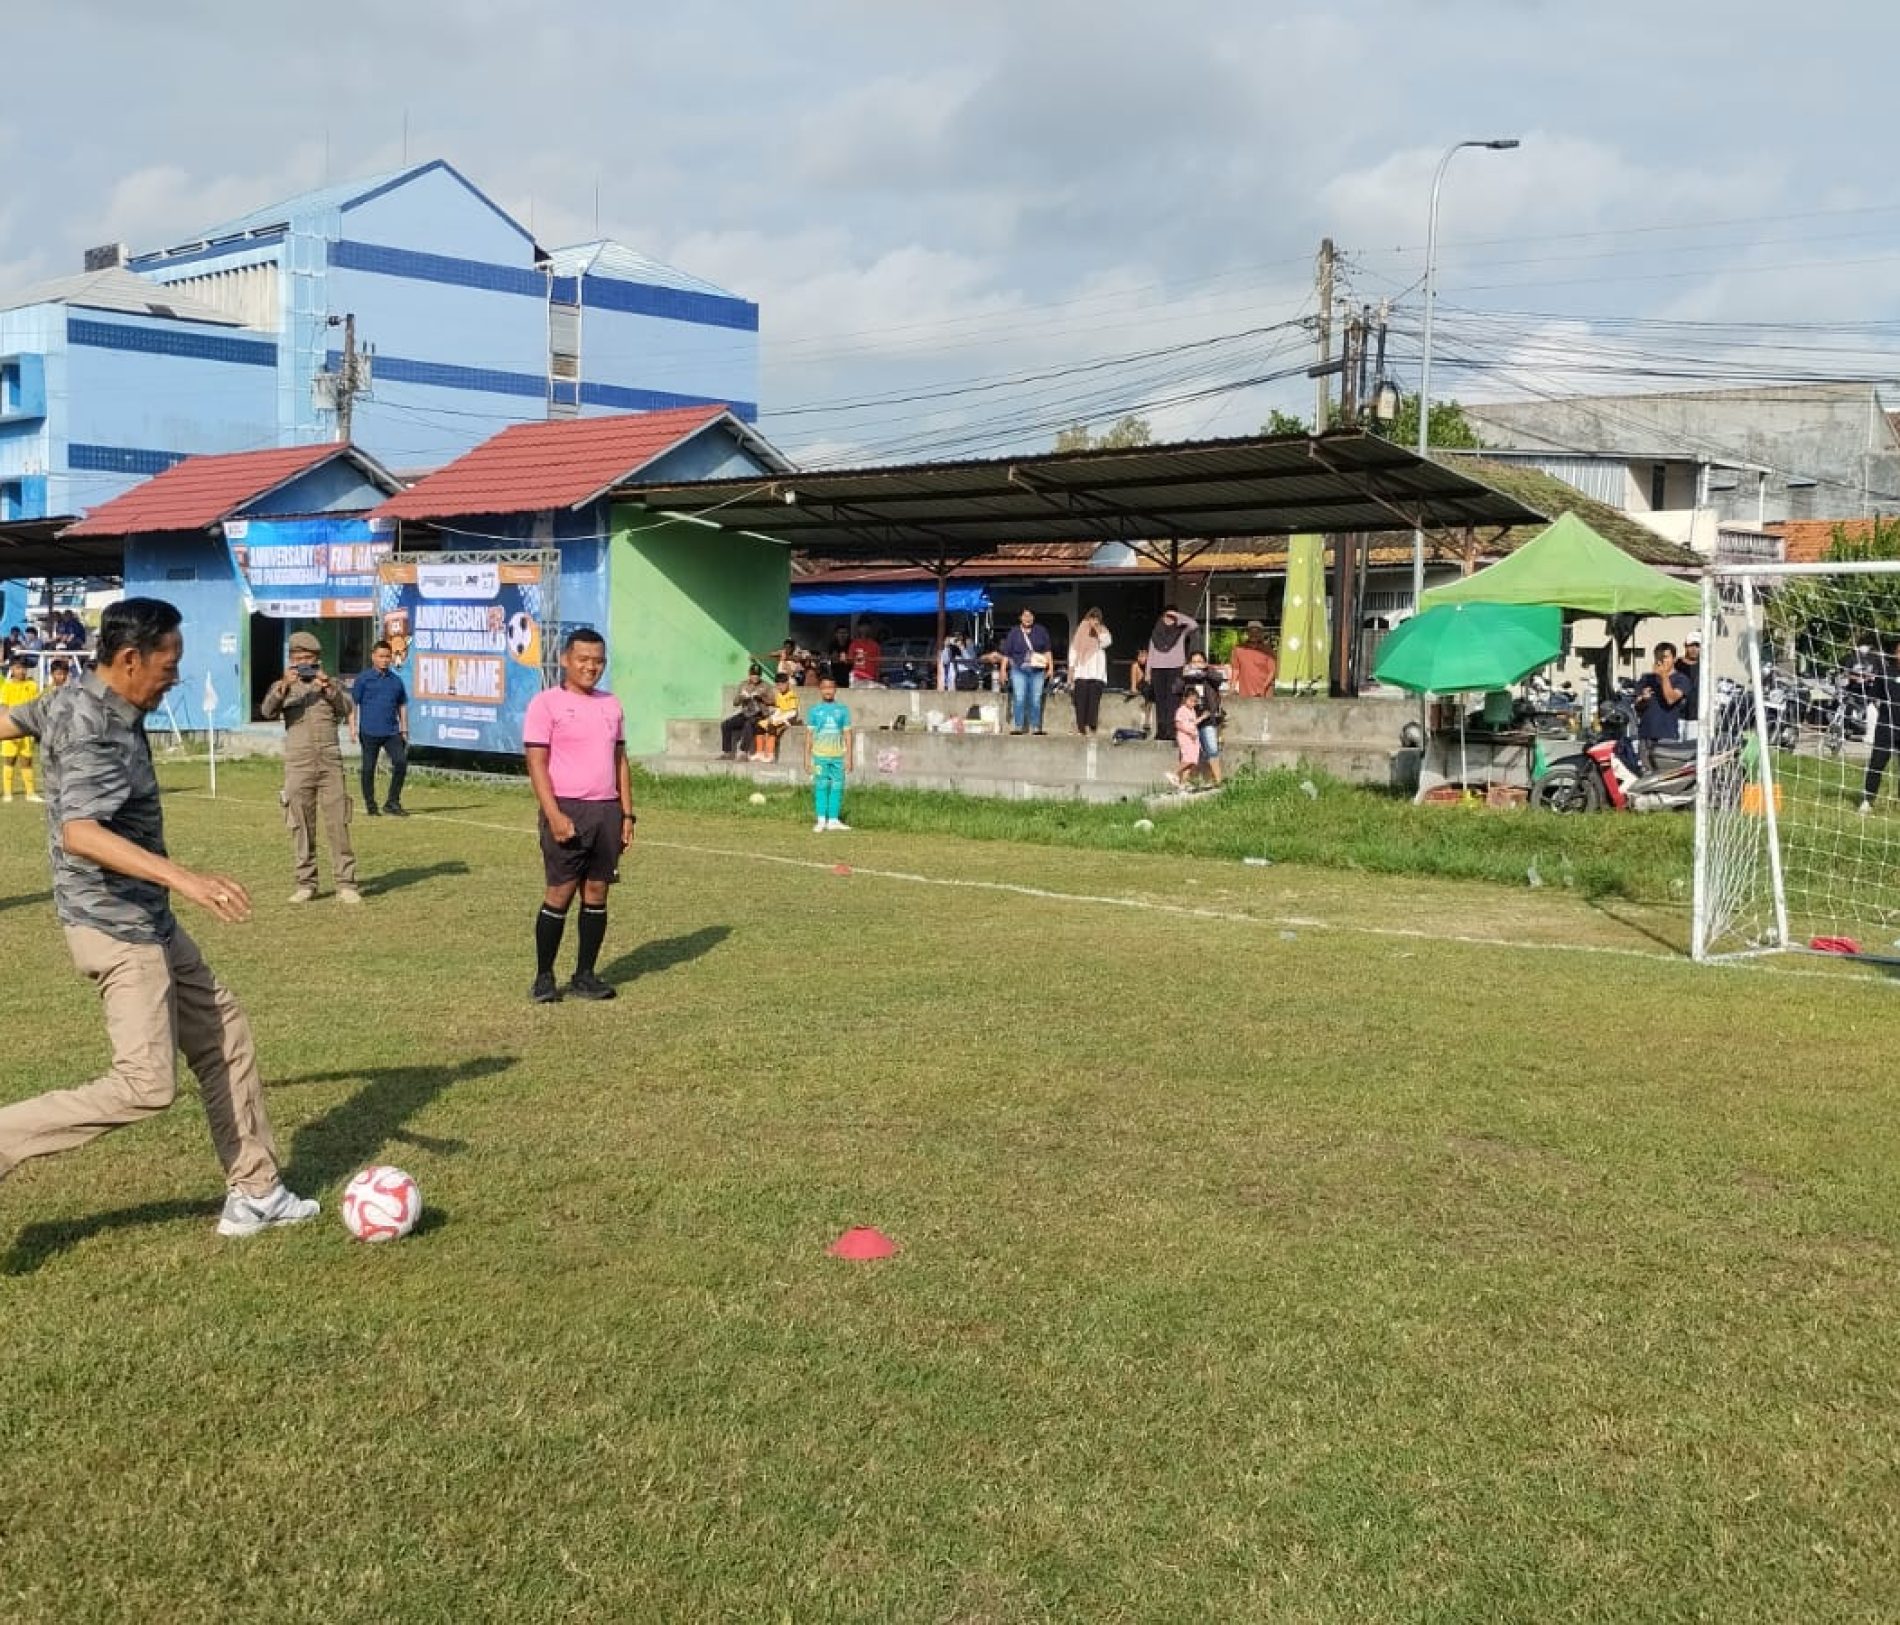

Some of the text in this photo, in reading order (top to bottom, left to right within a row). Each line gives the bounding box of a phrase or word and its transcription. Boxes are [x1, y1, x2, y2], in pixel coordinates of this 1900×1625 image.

[416, 605, 487, 629] ANNIVERSARY
[419, 657, 501, 698] FUN GAME
